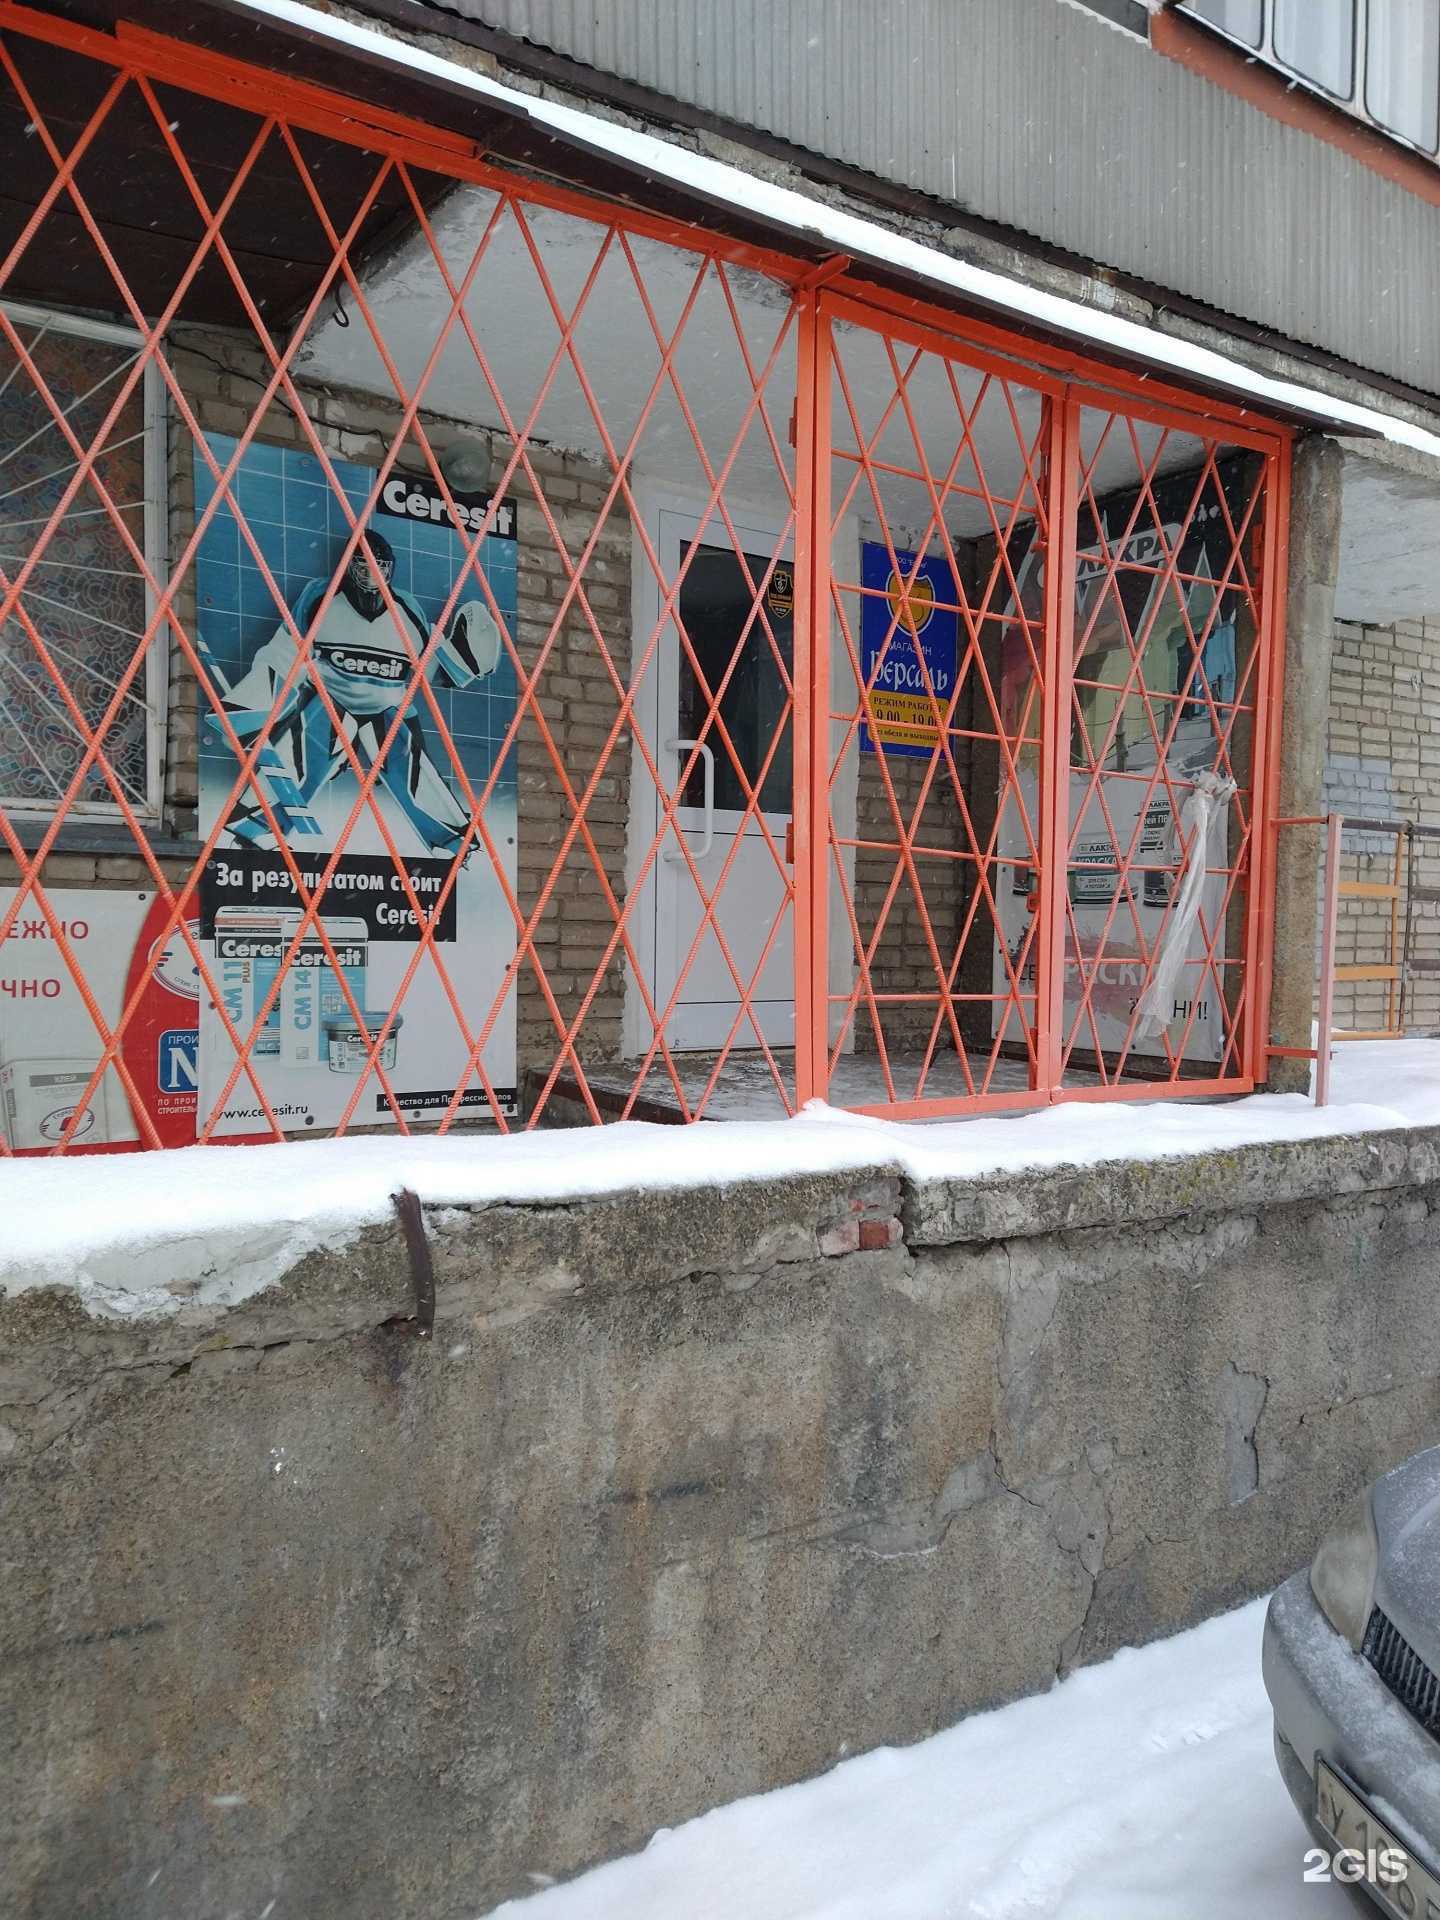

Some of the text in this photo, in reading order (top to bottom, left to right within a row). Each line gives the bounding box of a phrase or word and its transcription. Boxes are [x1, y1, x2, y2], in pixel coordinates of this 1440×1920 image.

[383, 480, 513, 535] Ceresit
[330, 651, 403, 678] Ceresit
[215, 862, 244, 887] За
[376, 902, 442, 925] Ceresi
[242, 961, 250, 983] PLUS
[212, 1103, 308, 1119] ww.ceesit.ru
[383, 1098, 423, 1107] Кчество
[425, 1096, 440, 1105] для
